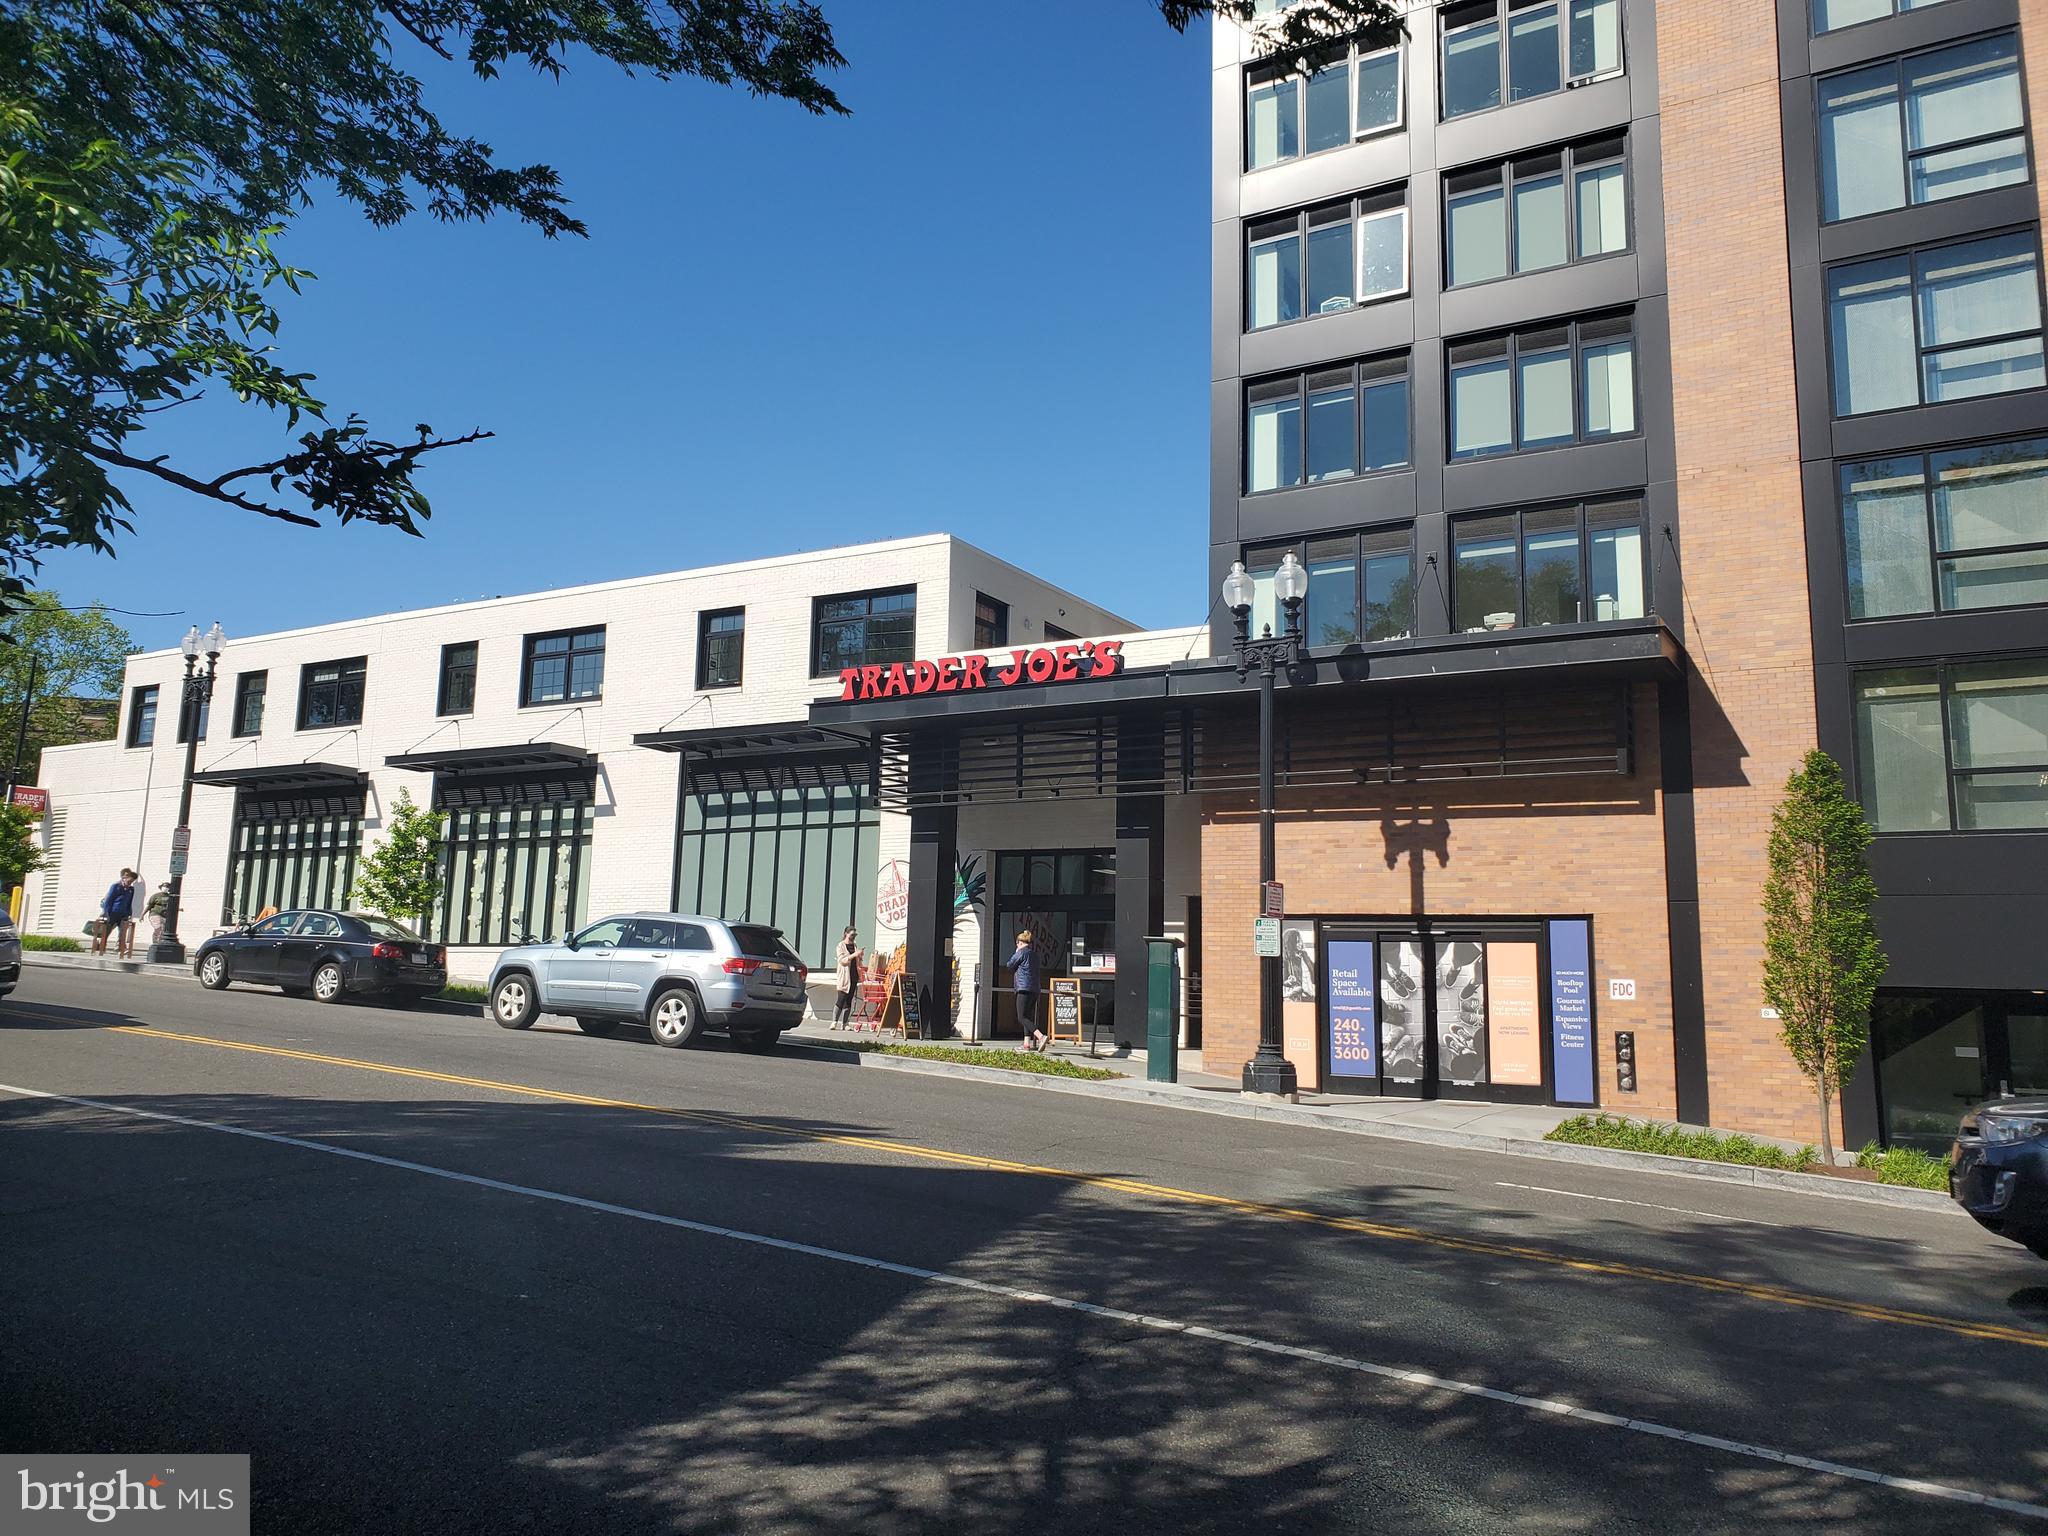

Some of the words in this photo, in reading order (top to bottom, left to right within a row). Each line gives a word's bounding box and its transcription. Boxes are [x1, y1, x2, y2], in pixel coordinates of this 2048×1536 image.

[839, 655, 989, 701] TRADER
[997, 641, 1122, 686] JOE'S
[878, 894, 907, 914] TRAD
[1332, 969, 1357, 978] Retail
[1332, 979, 1358, 989] Space
[1557, 979, 1584, 988] Rooftop
[1612, 983, 1633, 996] FDC
[1332, 987, 1371, 997] Available
[1334, 1018, 1365, 1031] 240.
[1555, 1015, 1588, 1024] Expansive
[1334, 1033, 1365, 1046] 333.
[1334, 1047, 1370, 1060] 3600
